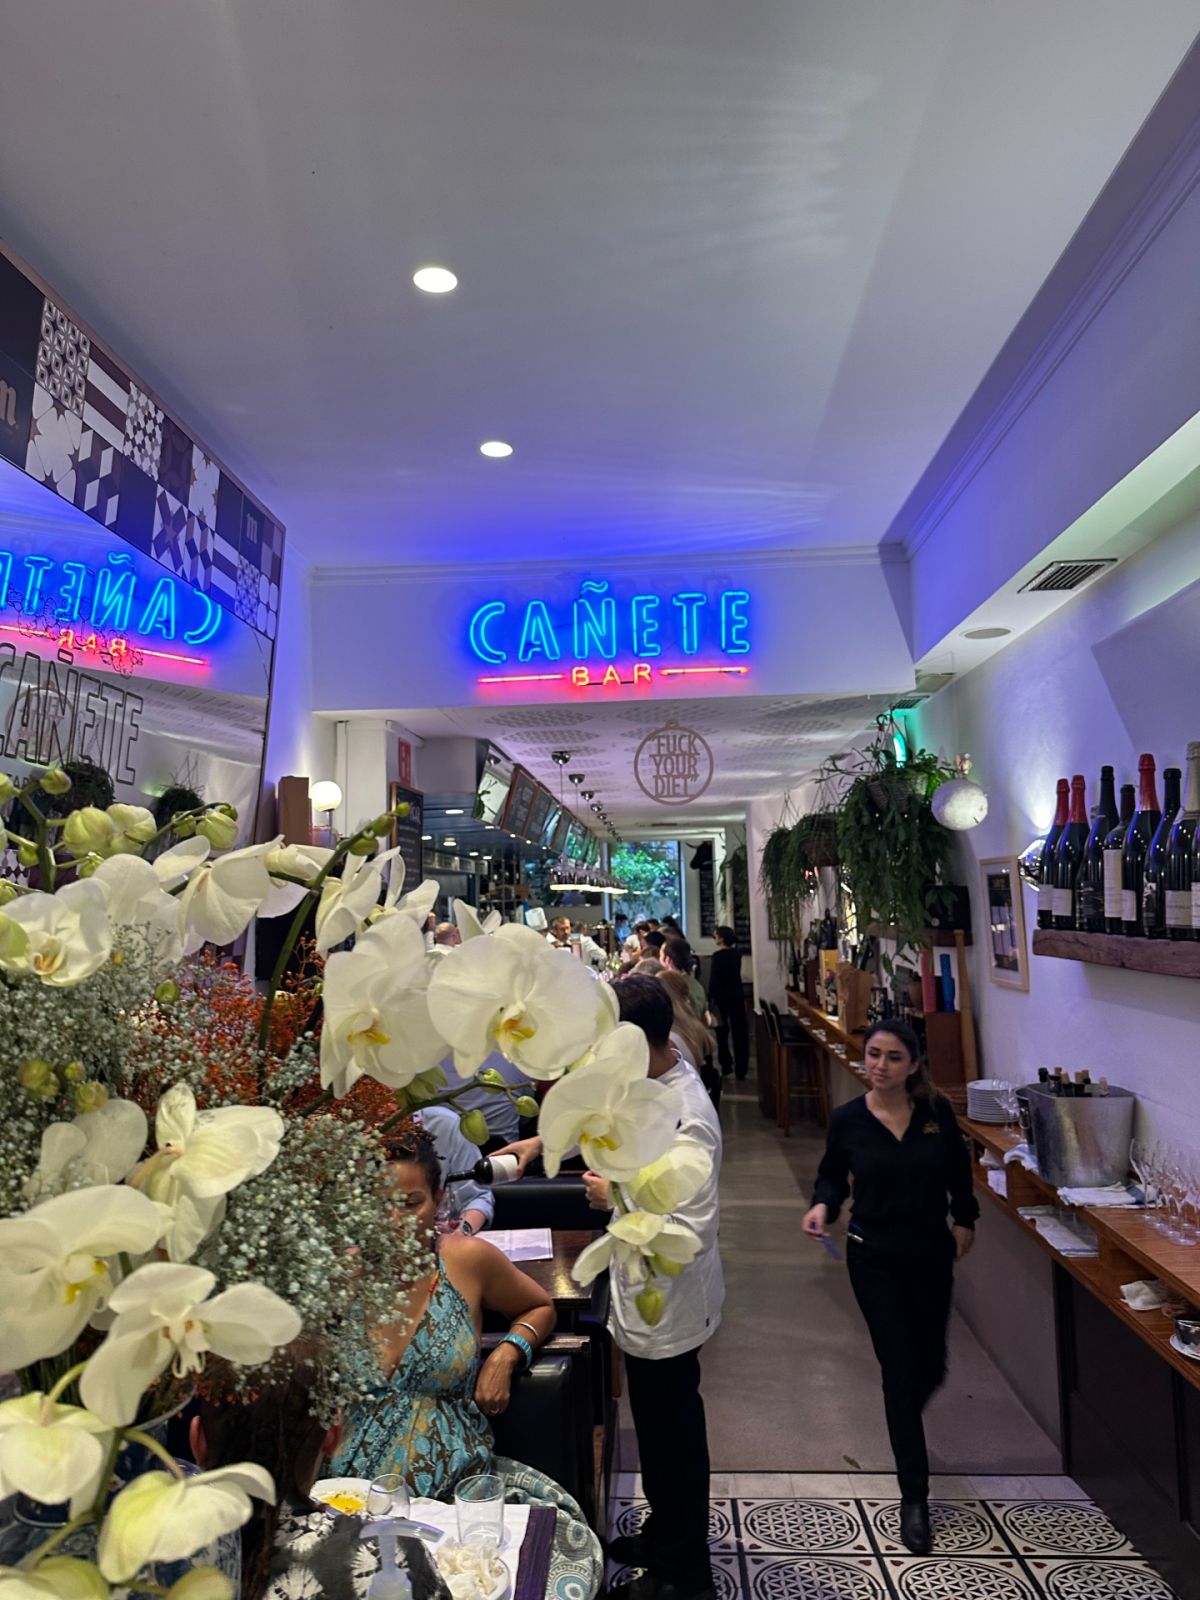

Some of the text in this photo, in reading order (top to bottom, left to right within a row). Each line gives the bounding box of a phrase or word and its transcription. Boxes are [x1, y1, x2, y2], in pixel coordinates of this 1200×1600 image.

[469, 580, 751, 664] CAÑETE
[571, 663, 652, 686] BAR
[651, 752, 699, 777] YOUR
